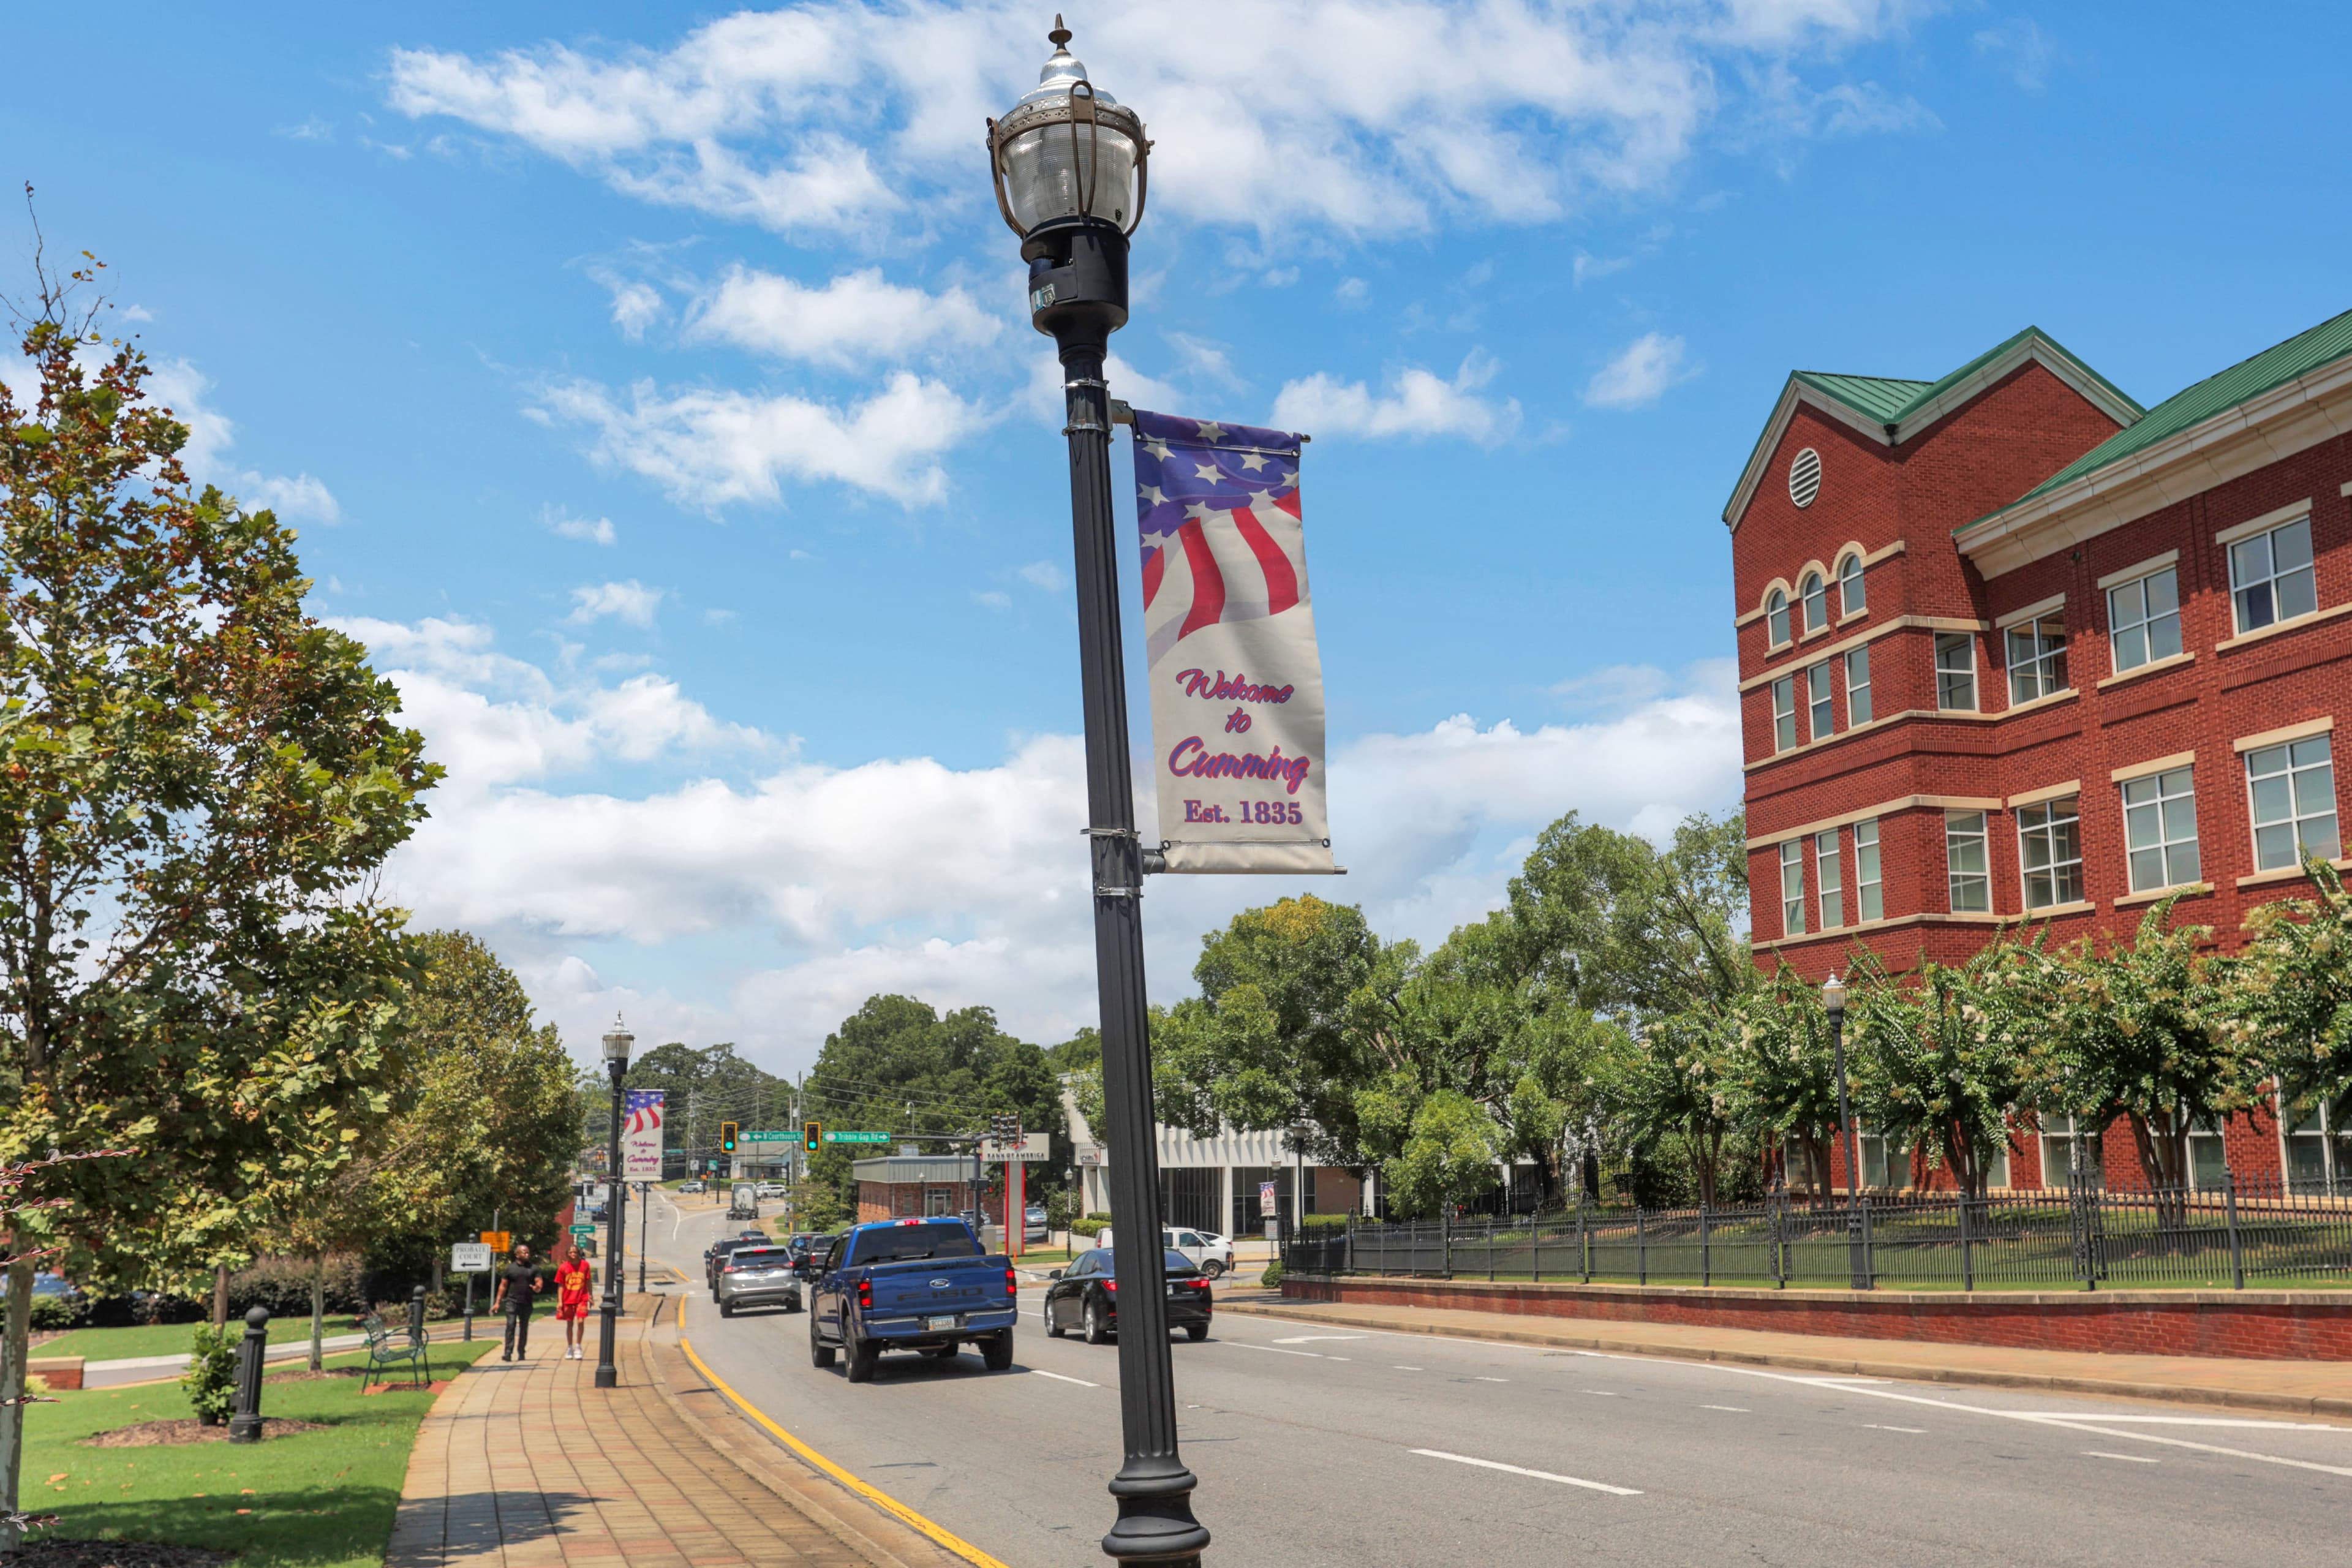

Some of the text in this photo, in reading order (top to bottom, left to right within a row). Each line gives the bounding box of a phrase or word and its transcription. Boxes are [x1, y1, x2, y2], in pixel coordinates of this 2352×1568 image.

[1175, 668, 1294, 704] Welcome
[1225, 707, 1251, 733] to
[1169, 736, 1310, 795] Cumming
[1183, 799, 1303, 825] Est. 1835
[859, 1133, 869, 1142] Gap
[897, 1287, 984, 1302] F-150
